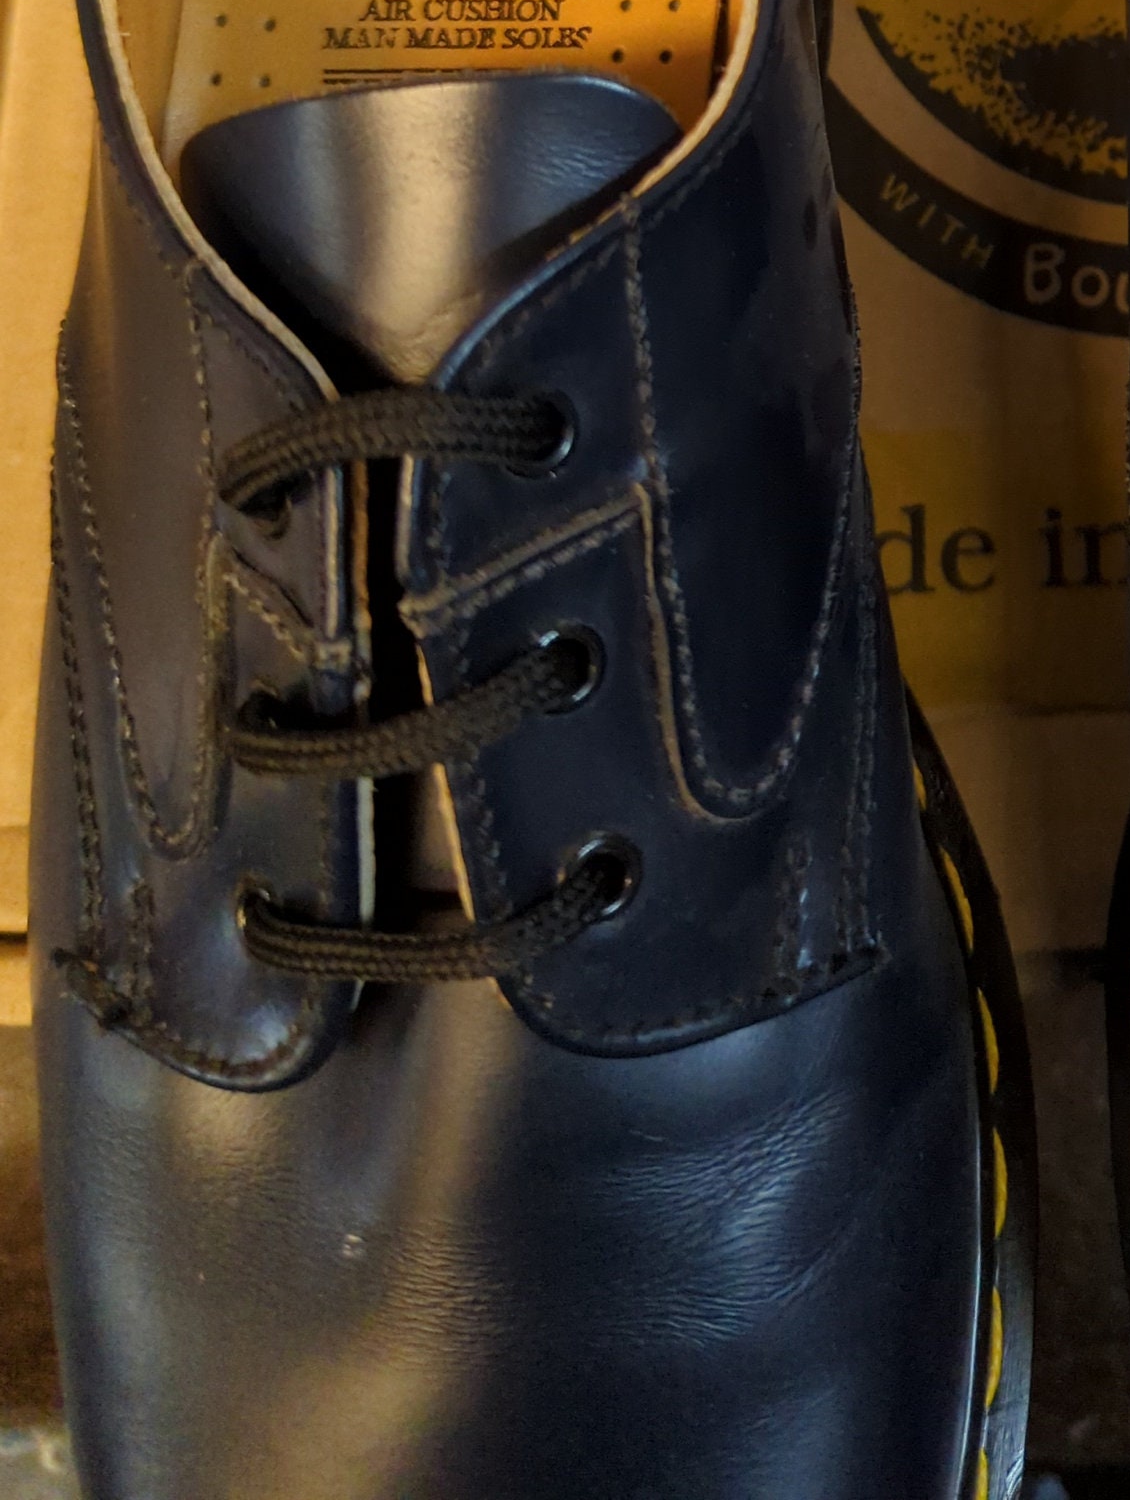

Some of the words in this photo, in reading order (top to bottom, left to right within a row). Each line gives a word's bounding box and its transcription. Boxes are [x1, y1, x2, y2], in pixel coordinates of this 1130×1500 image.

[422, 0, 566, 22] CUSHION
[321, 27, 402, 49] MAN
[404, 27, 496, 49] MADE
[502, 26, 595, 49] SOLES
[880, 174, 996, 271] WITH
